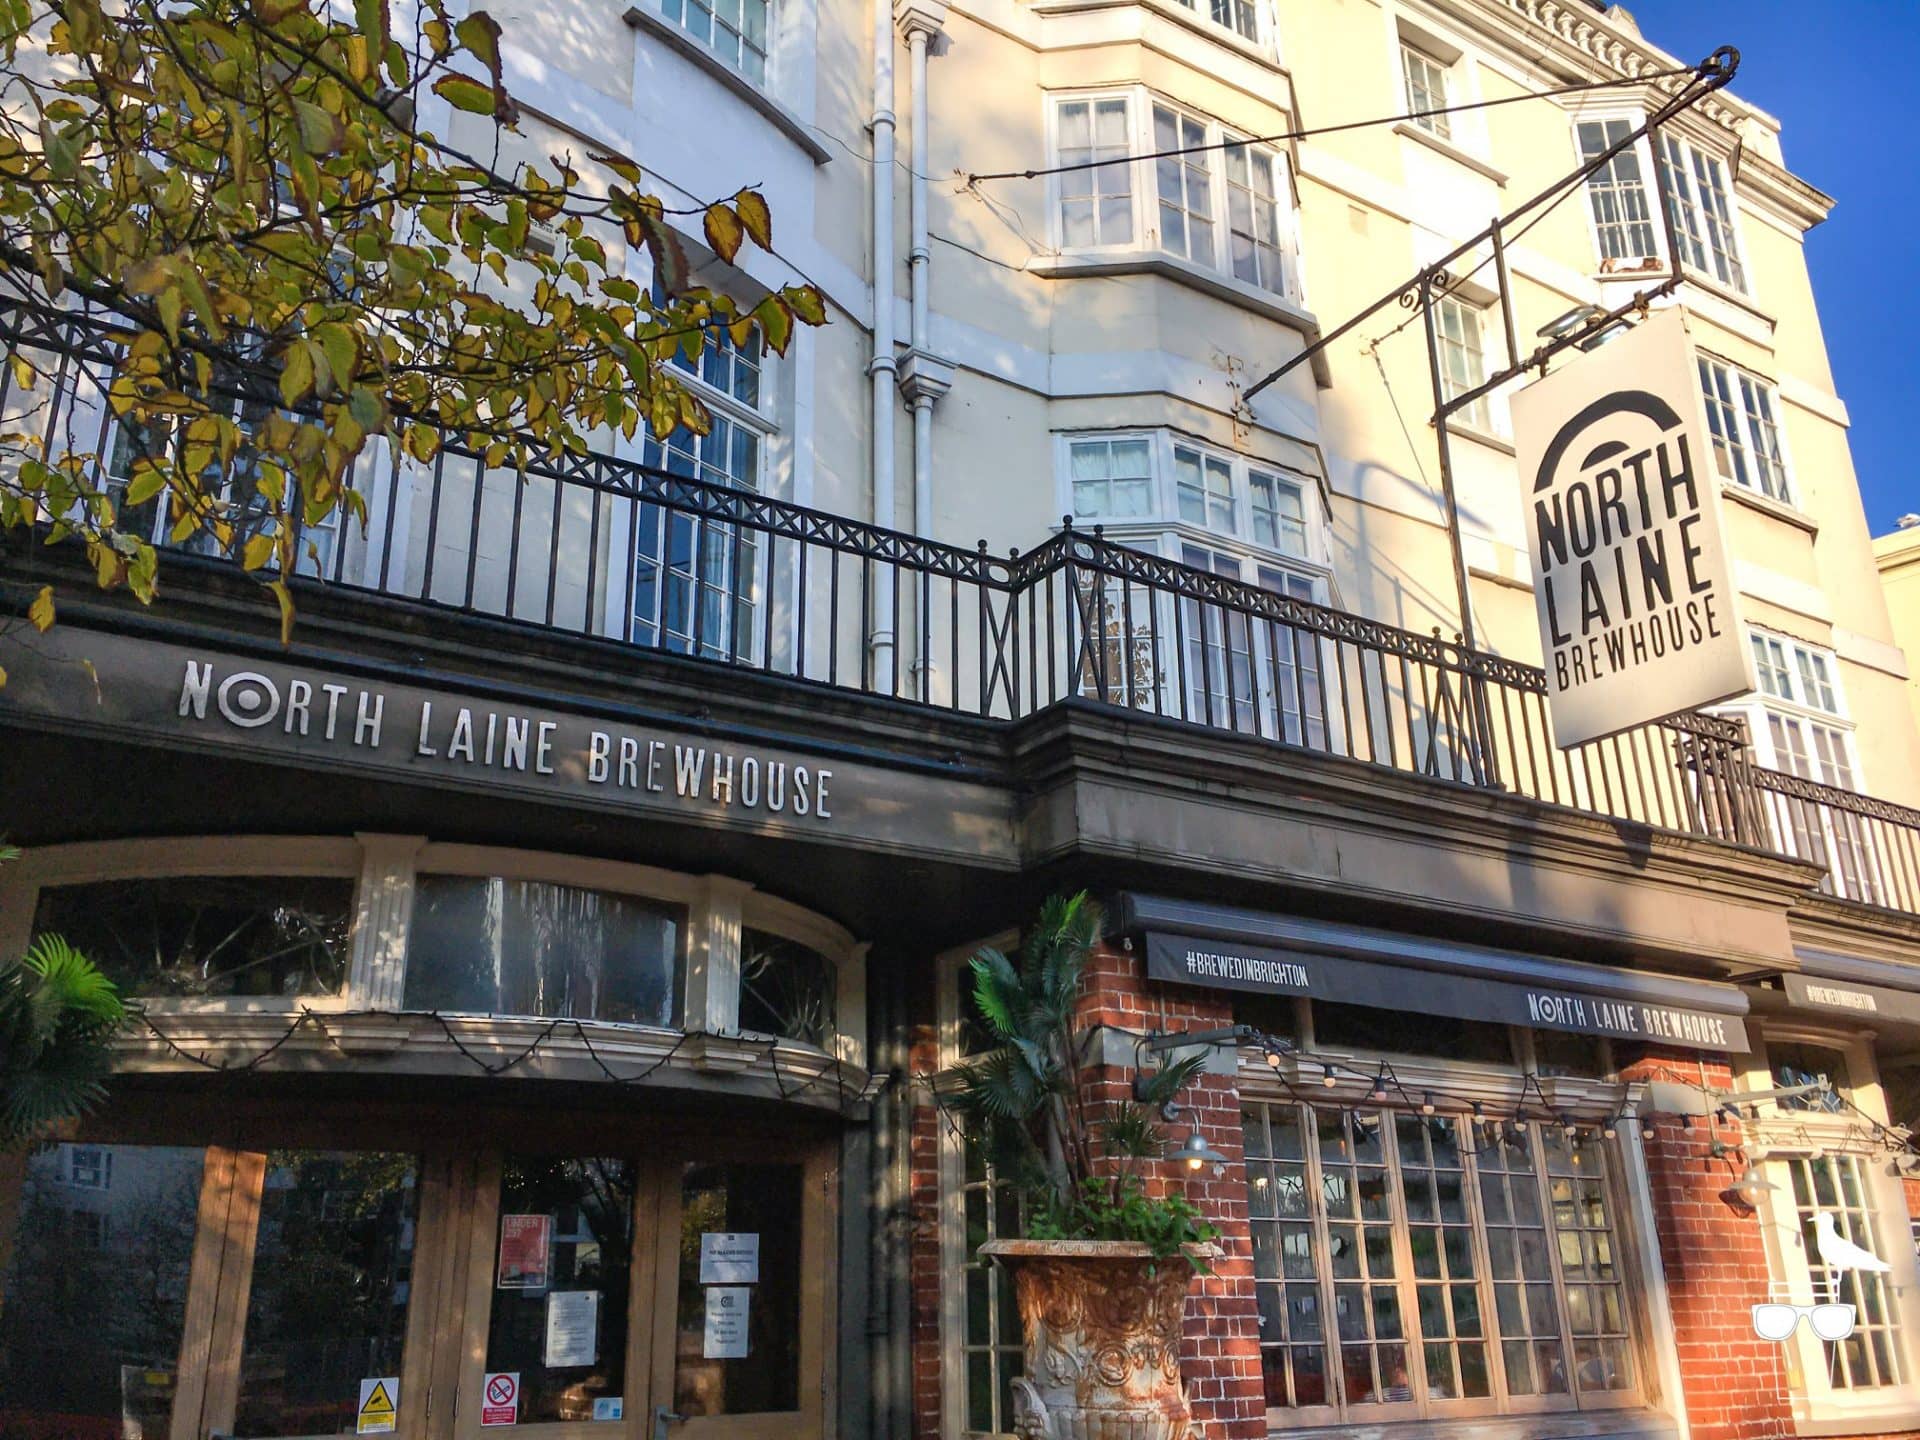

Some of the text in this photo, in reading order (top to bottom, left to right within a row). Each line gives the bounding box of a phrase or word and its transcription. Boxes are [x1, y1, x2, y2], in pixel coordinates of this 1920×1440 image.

[1534, 434, 1698, 572] NORTH
[1543, 513, 1712, 648] LAINE
[1554, 594, 1721, 692] BREWHOUSE
[178, 660, 833, 818] NORTH LAINE BREWHOUSE
[1186, 950, 1309, 987] #BREWEDINBRIGHTON
[1527, 993, 1727, 1045] NORTH LAINE BREWHOUSE
